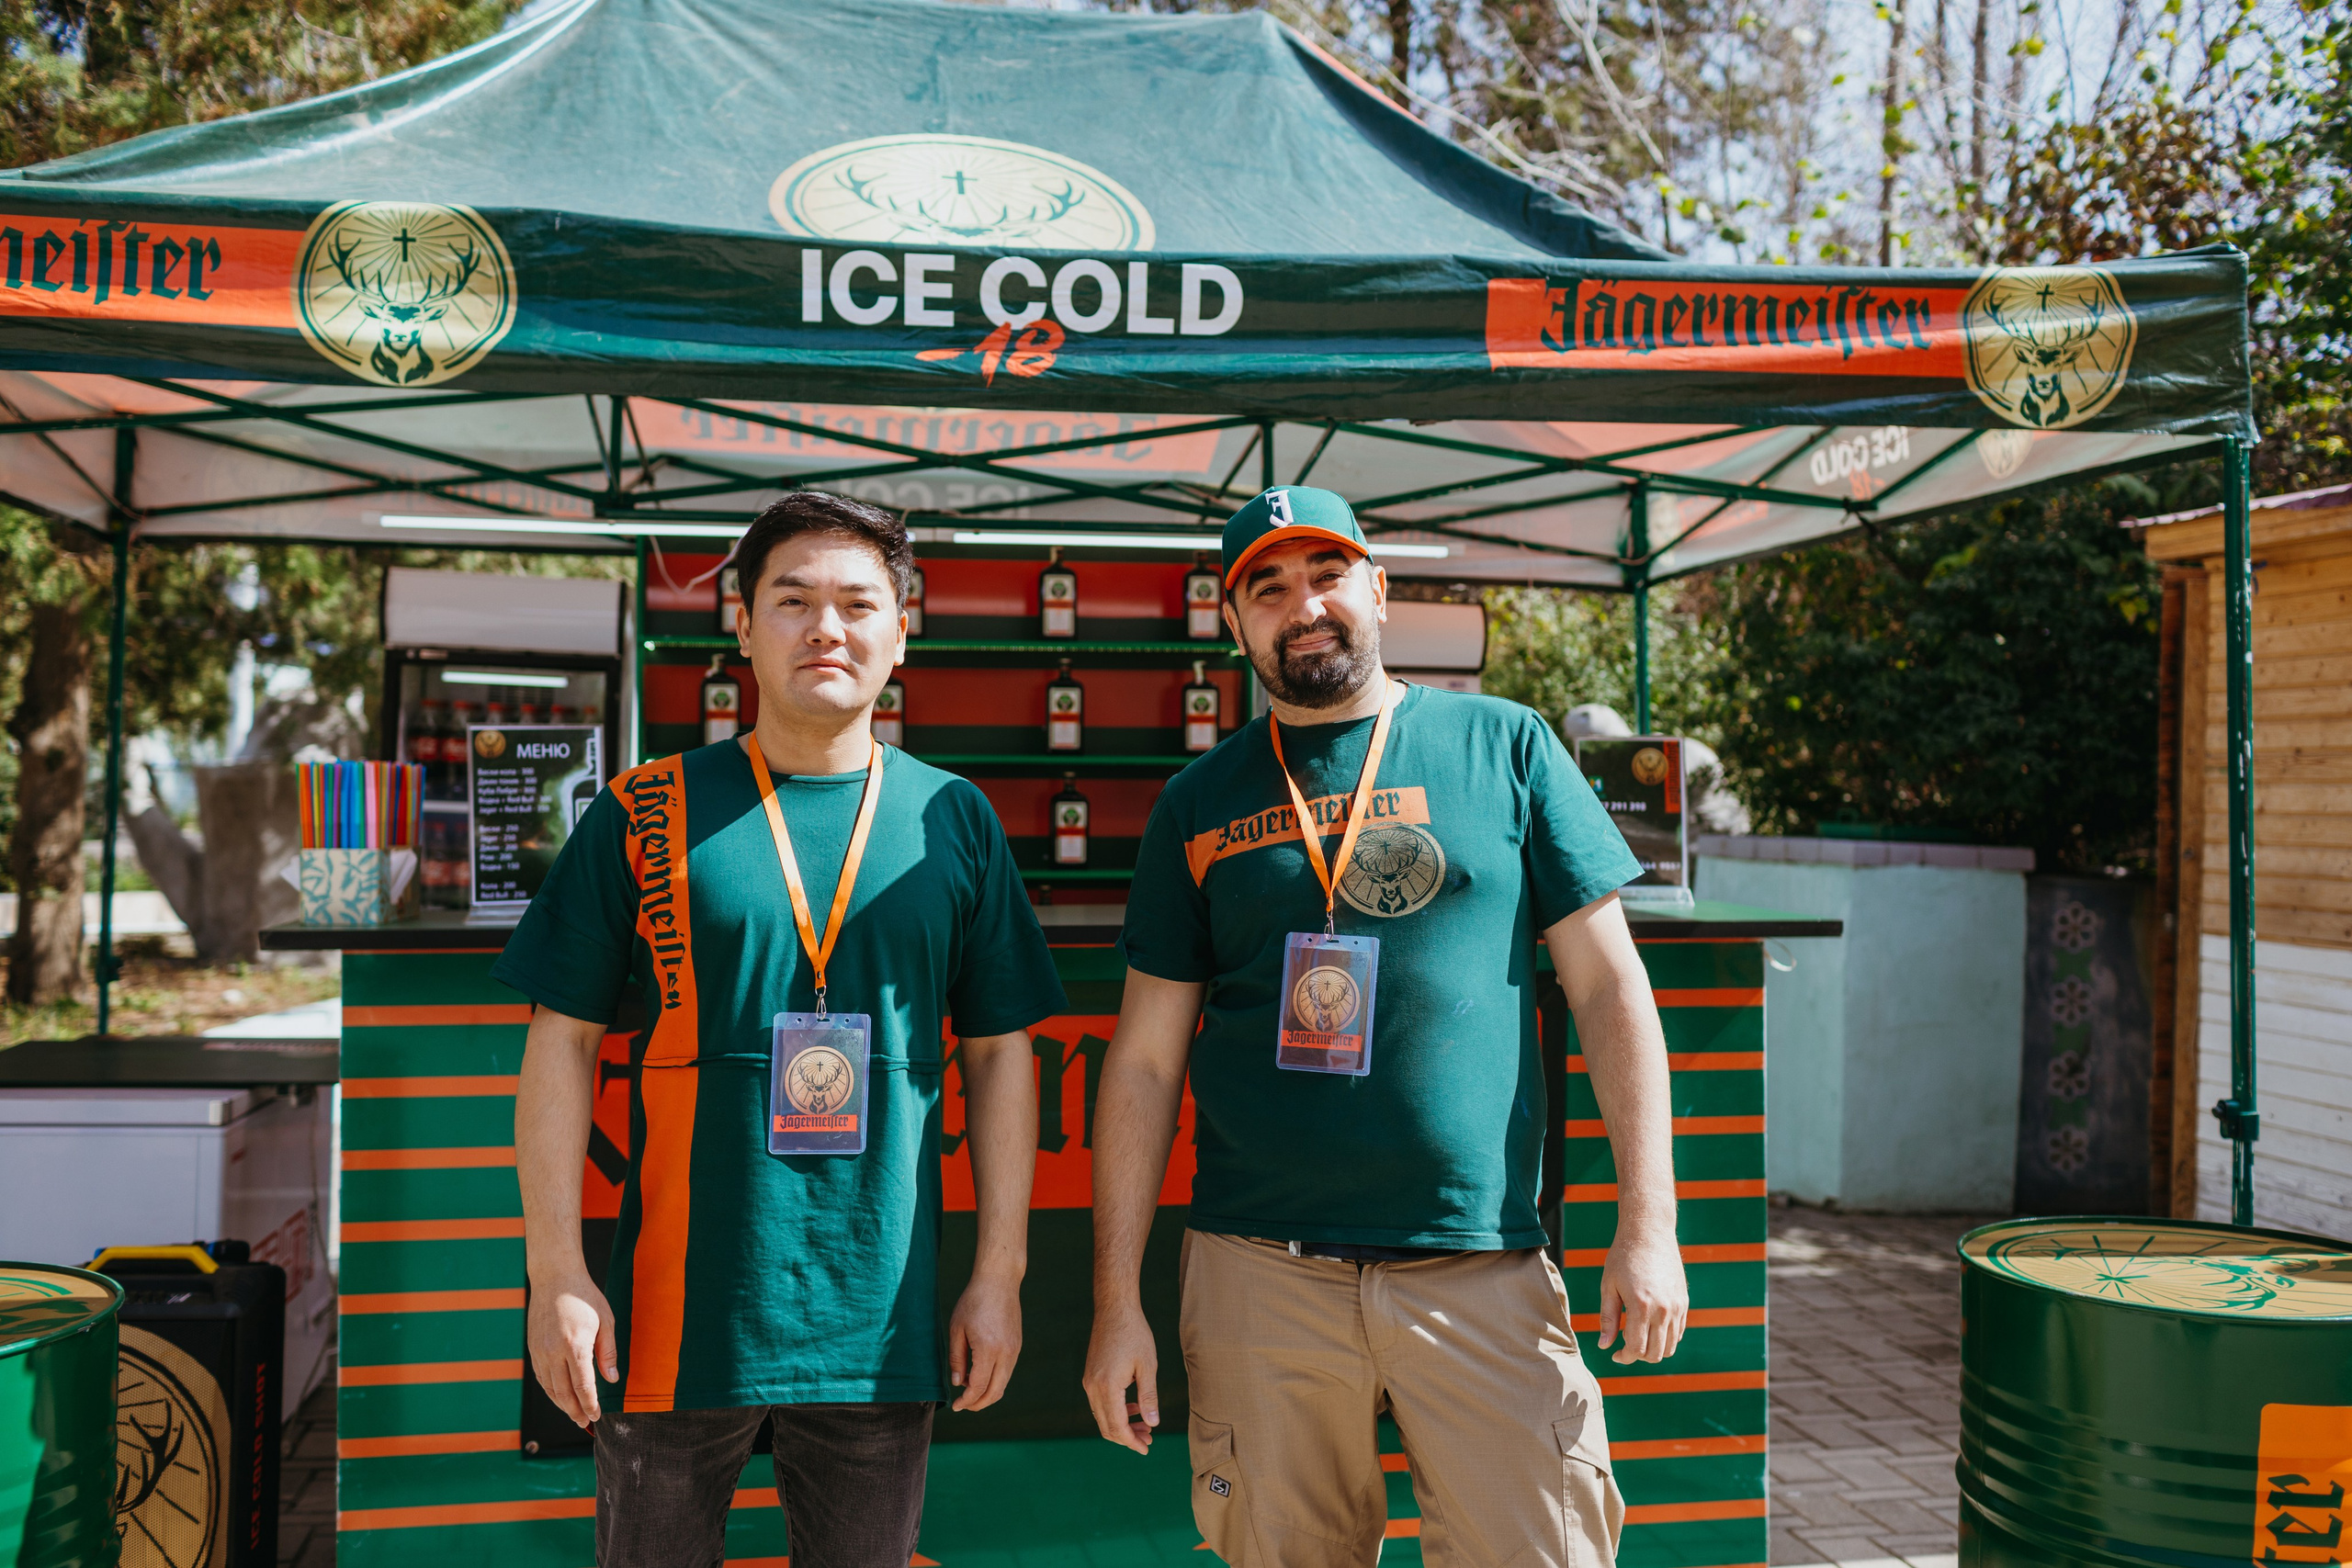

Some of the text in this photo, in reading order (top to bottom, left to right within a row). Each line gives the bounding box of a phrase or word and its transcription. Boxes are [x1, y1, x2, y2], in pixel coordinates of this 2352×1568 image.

[801, 248, 1244, 336] ICE COLD
[1541, 276, 1932, 361] Jägermeister
[516, 743, 571, 759] МЕНЮ
[253, 1433, 264, 1502] COLD
